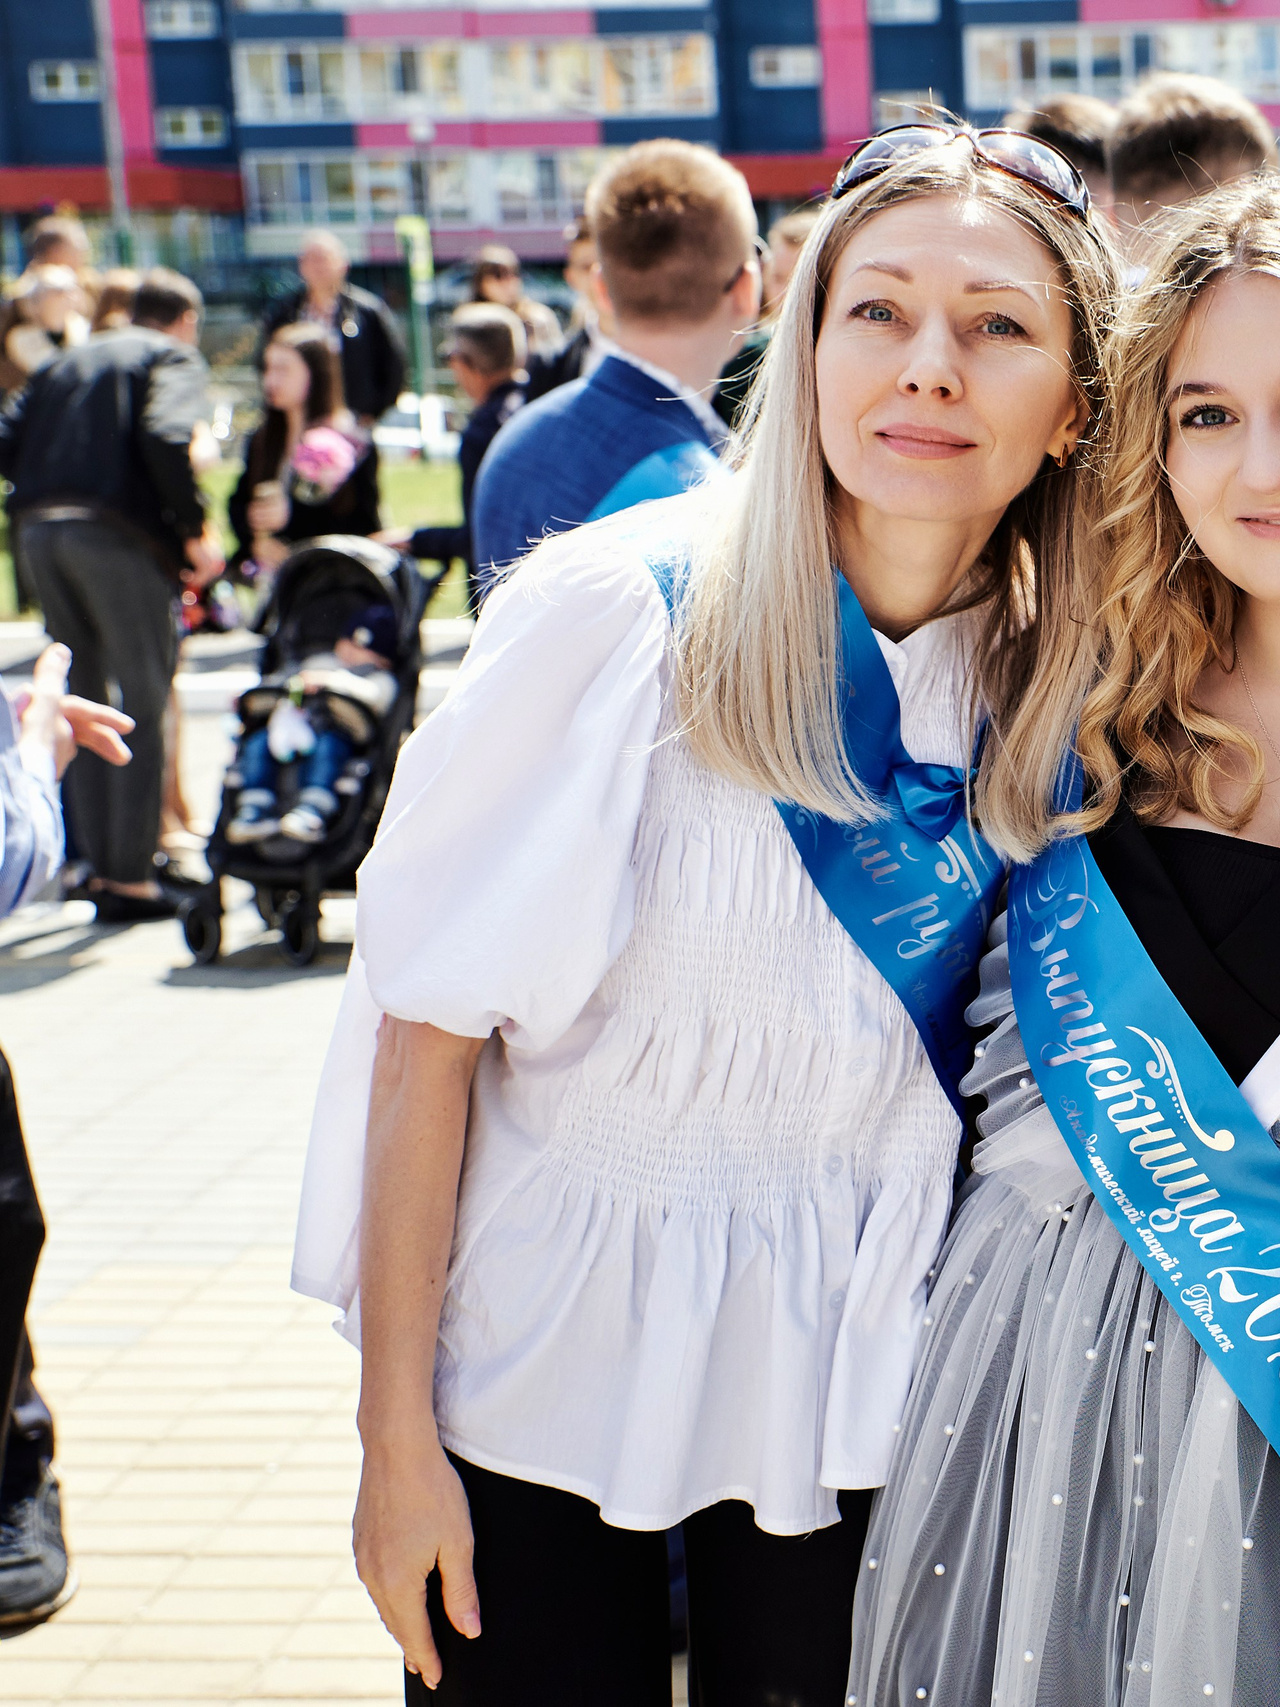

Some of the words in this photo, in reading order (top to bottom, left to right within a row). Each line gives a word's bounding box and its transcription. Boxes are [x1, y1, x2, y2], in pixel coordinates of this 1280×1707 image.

[1025, 839, 1246, 1254] Выпускница
[1058, 1095, 1147, 1225] Академический
[1136, 1226, 1180, 1273] лицей
[1180, 1283, 1235, 1353] Томск
